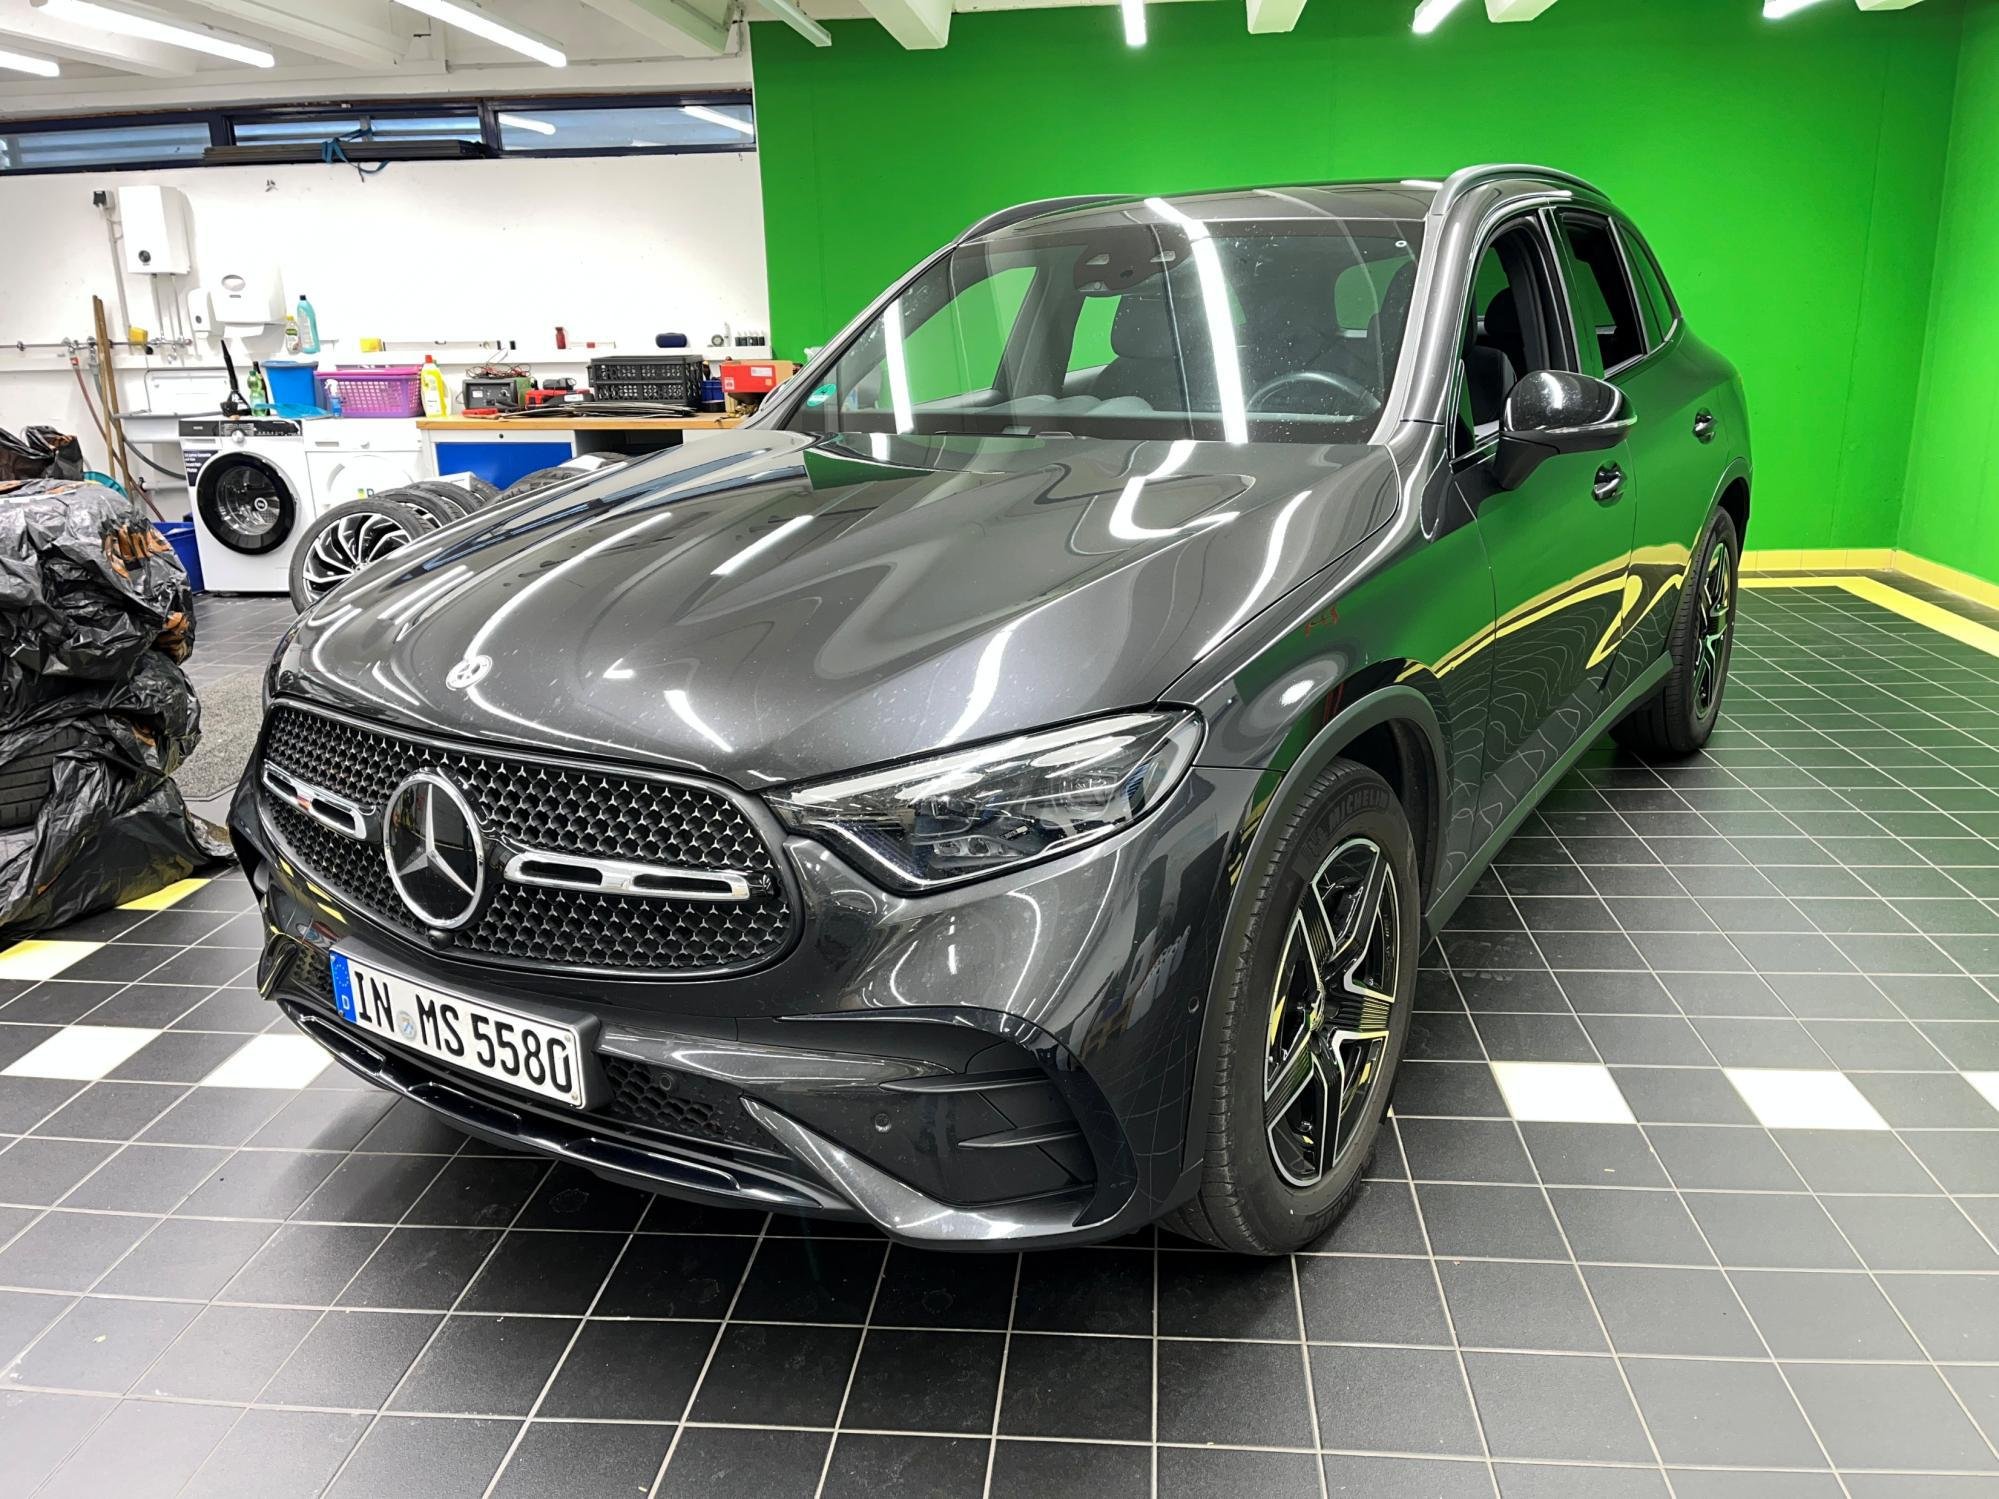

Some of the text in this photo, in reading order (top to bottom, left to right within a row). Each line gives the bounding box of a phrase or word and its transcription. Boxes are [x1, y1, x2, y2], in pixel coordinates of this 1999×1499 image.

[1329, 788, 1389, 832] MICHELIN
[341, 994, 350, 1010] D
[354, 970, 573, 1094] IN MS 5580
